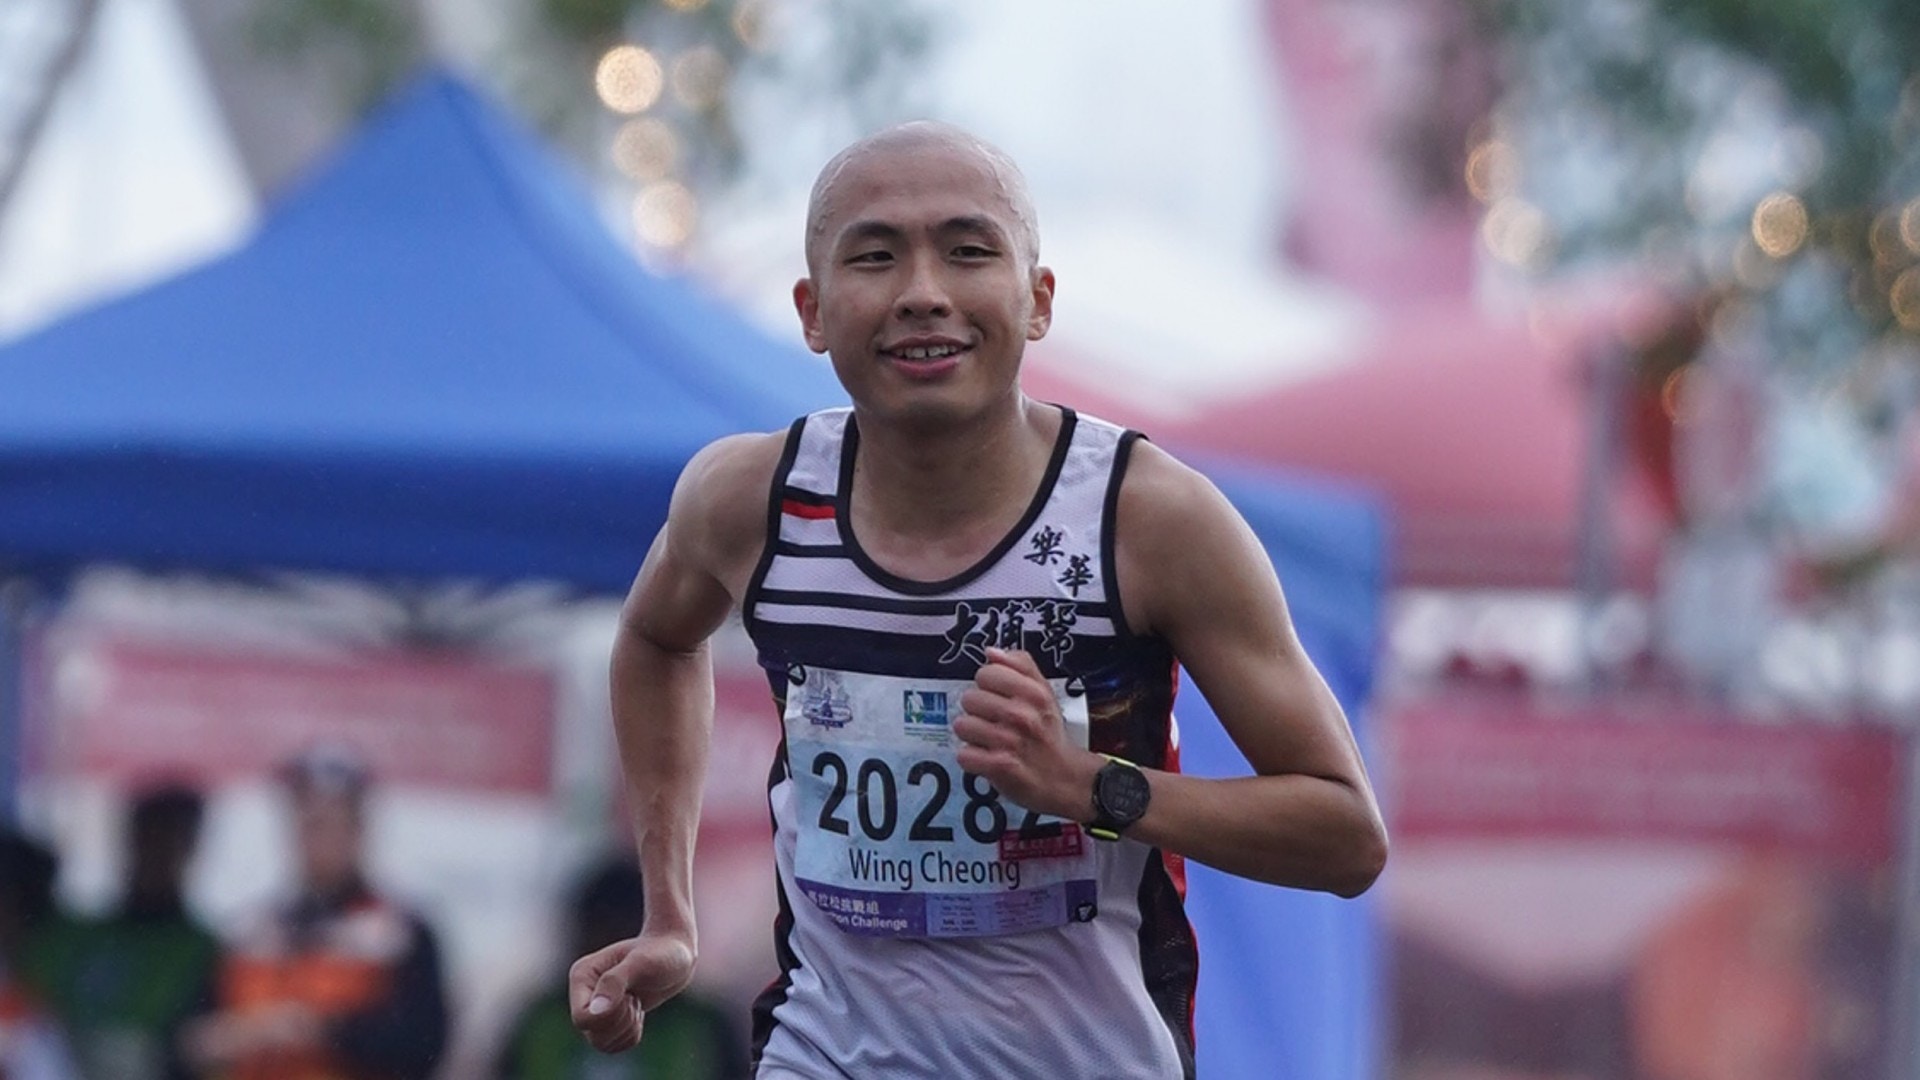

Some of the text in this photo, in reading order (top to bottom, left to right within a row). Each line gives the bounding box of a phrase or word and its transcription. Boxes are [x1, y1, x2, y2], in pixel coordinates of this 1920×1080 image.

[849, 848, 1021, 890] Wing Cheong
[851, 914, 908, 931] Challenge
